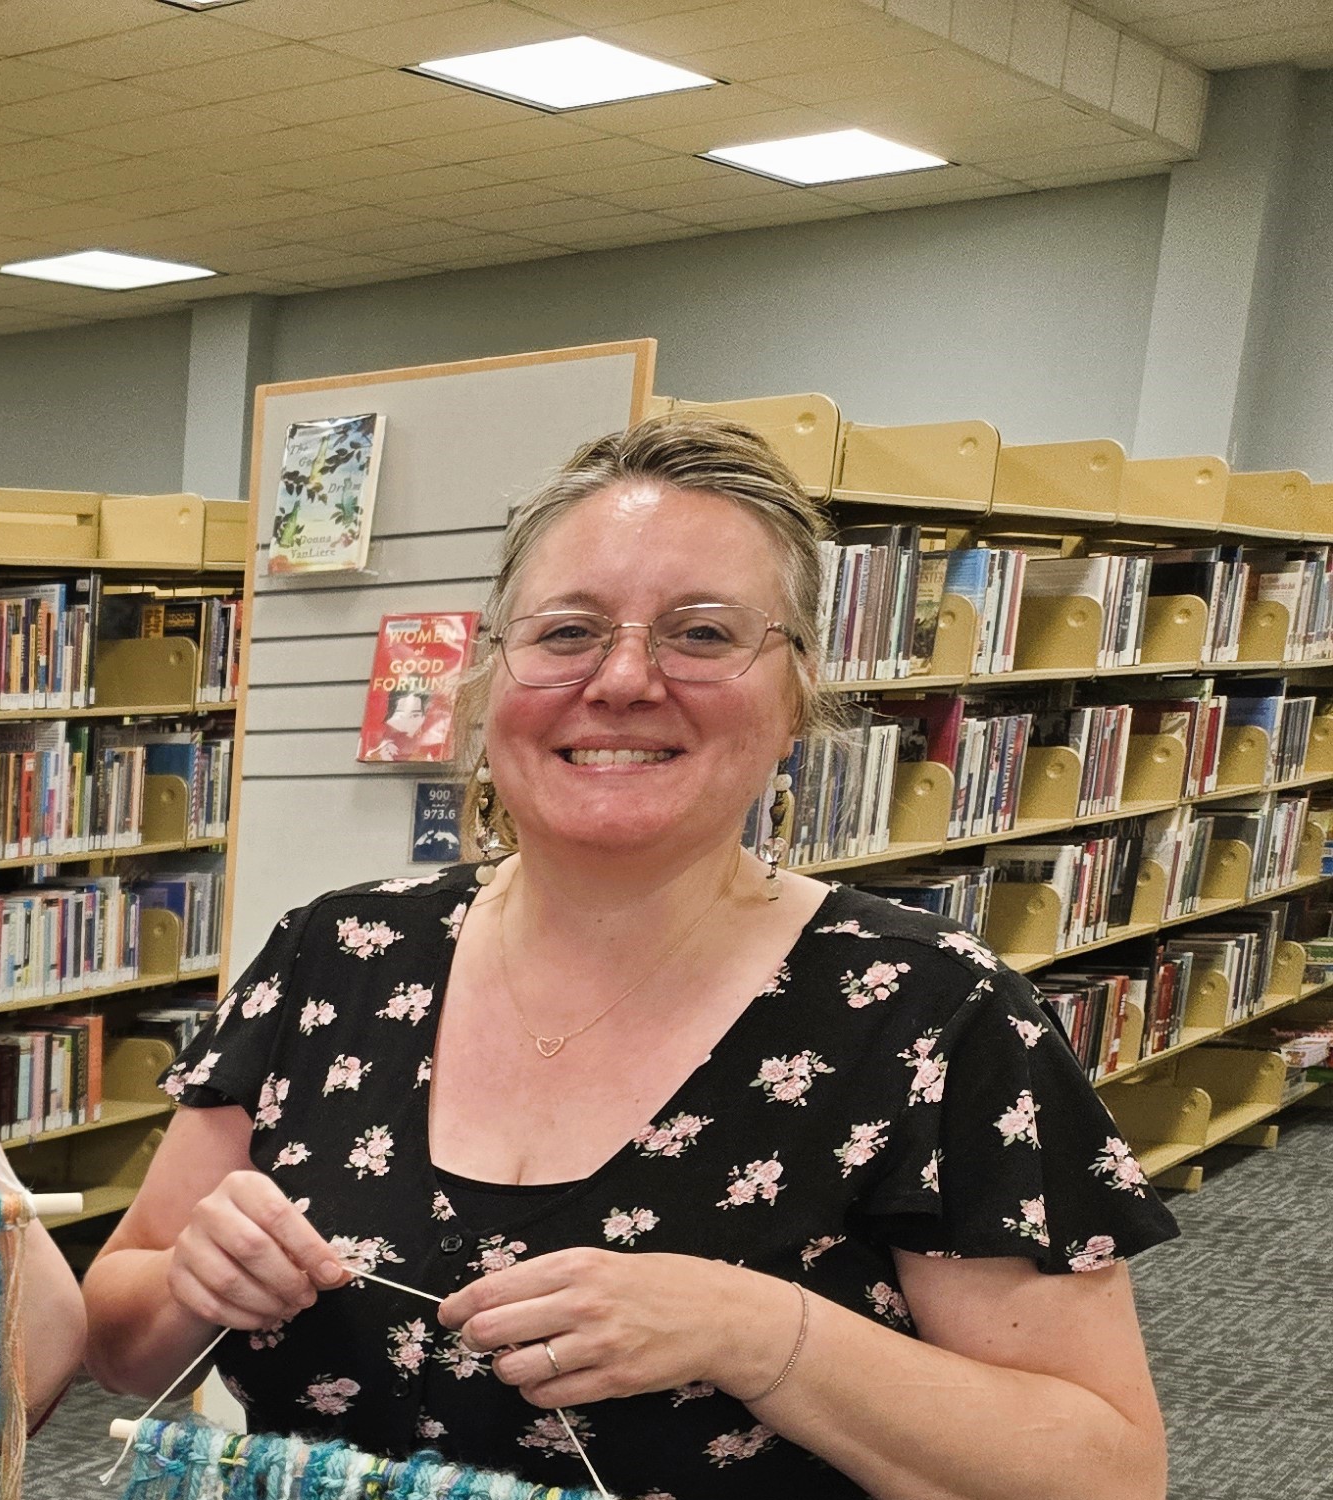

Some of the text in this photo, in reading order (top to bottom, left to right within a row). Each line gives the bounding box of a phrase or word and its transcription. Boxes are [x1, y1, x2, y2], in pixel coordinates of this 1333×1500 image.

[389, 629, 457, 645] WOMEN
[413, 646, 426, 656] of
[390, 658, 444, 674] GOOD
[373, 676, 446, 692] FORTUN
[424, 810, 456, 820] 973.6
